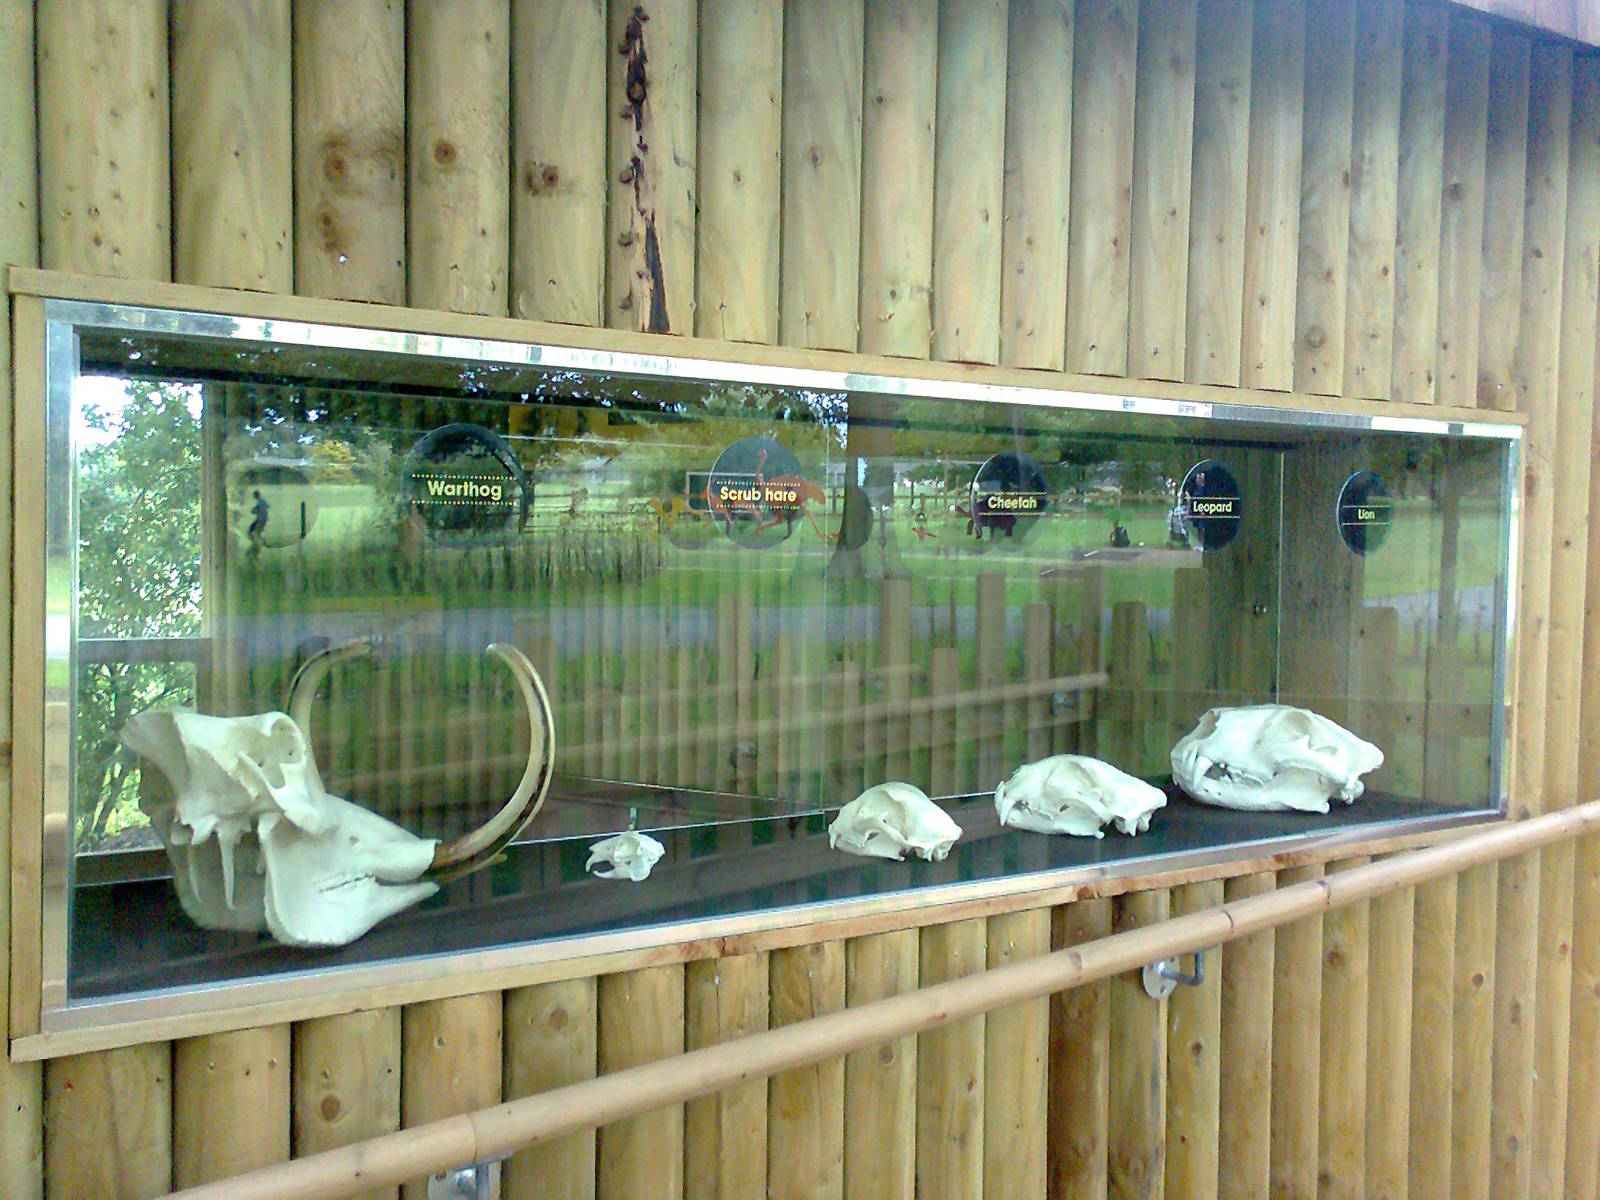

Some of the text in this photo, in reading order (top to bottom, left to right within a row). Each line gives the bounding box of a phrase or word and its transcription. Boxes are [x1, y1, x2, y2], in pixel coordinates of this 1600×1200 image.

[427, 480, 502, 501] Warthog
[720, 486, 797, 502] Scrub hare
[987, 496, 1037, 509] Cheetah
[1193, 501, 1232, 515] Leopard
[1358, 508, 1375, 520] Lion
